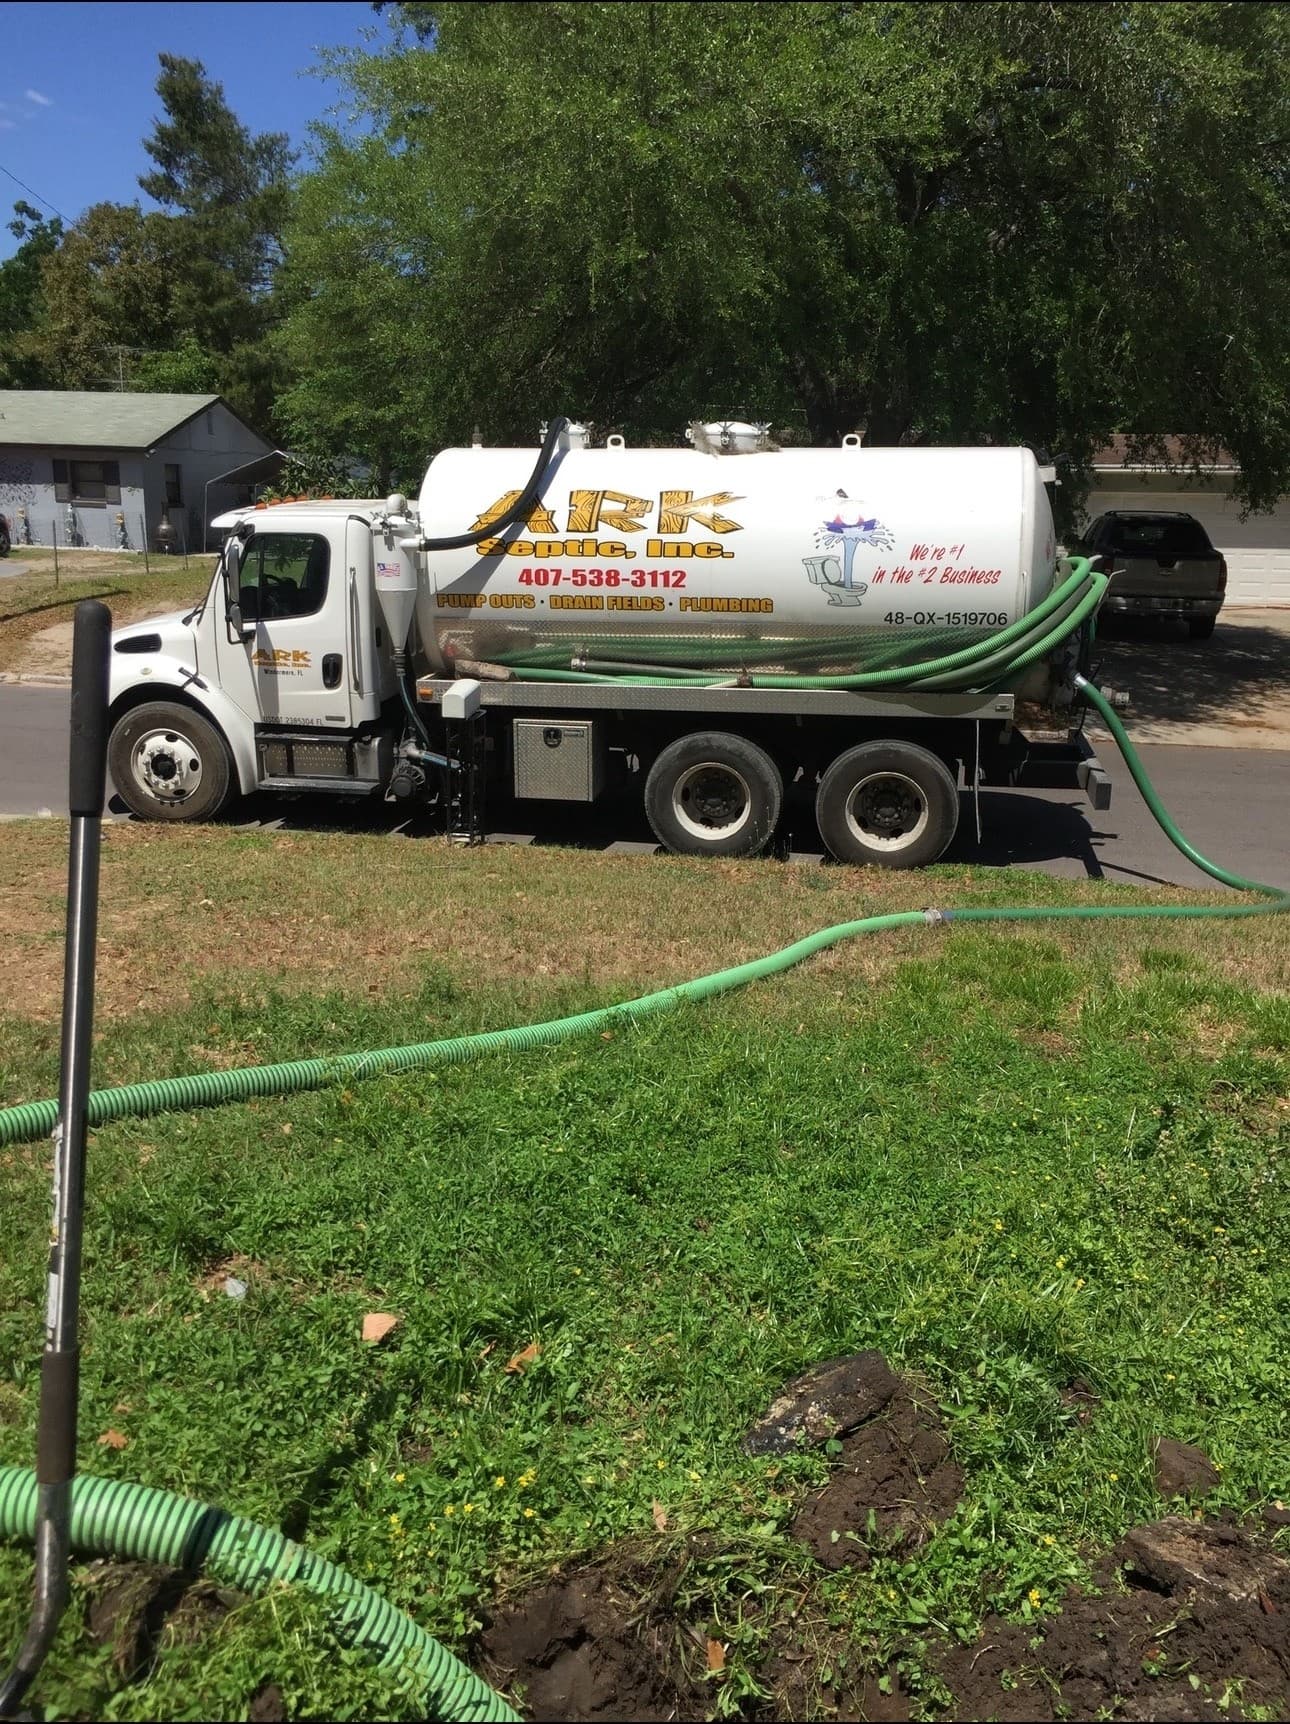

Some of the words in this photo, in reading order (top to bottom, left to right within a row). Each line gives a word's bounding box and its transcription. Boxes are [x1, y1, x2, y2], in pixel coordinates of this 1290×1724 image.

[467, 489, 748, 534] ARK
[476, 539, 636, 559] Septic,
[647, 539, 735, 558] Inc.
[910, 544, 947, 561] We're
[949, 544, 965, 560] #1
[518, 568, 687, 588] 407-538-3112
[872, 566, 886, 583] in
[890, 566, 913, 584] the
[918, 566, 937, 584] #2
[940, 567, 1002, 584] Business
[437, 593, 486, 608] PUMP
[489, 594, 535, 609] OUTS
[550, 595, 604, 610] DRAIN
[607, 596, 665, 611] FIELDS
[680, 596, 774, 613] PLUMBING
[883, 612, 1008, 626] 48-QX-1519706
[252, 648, 312, 662] ARK
